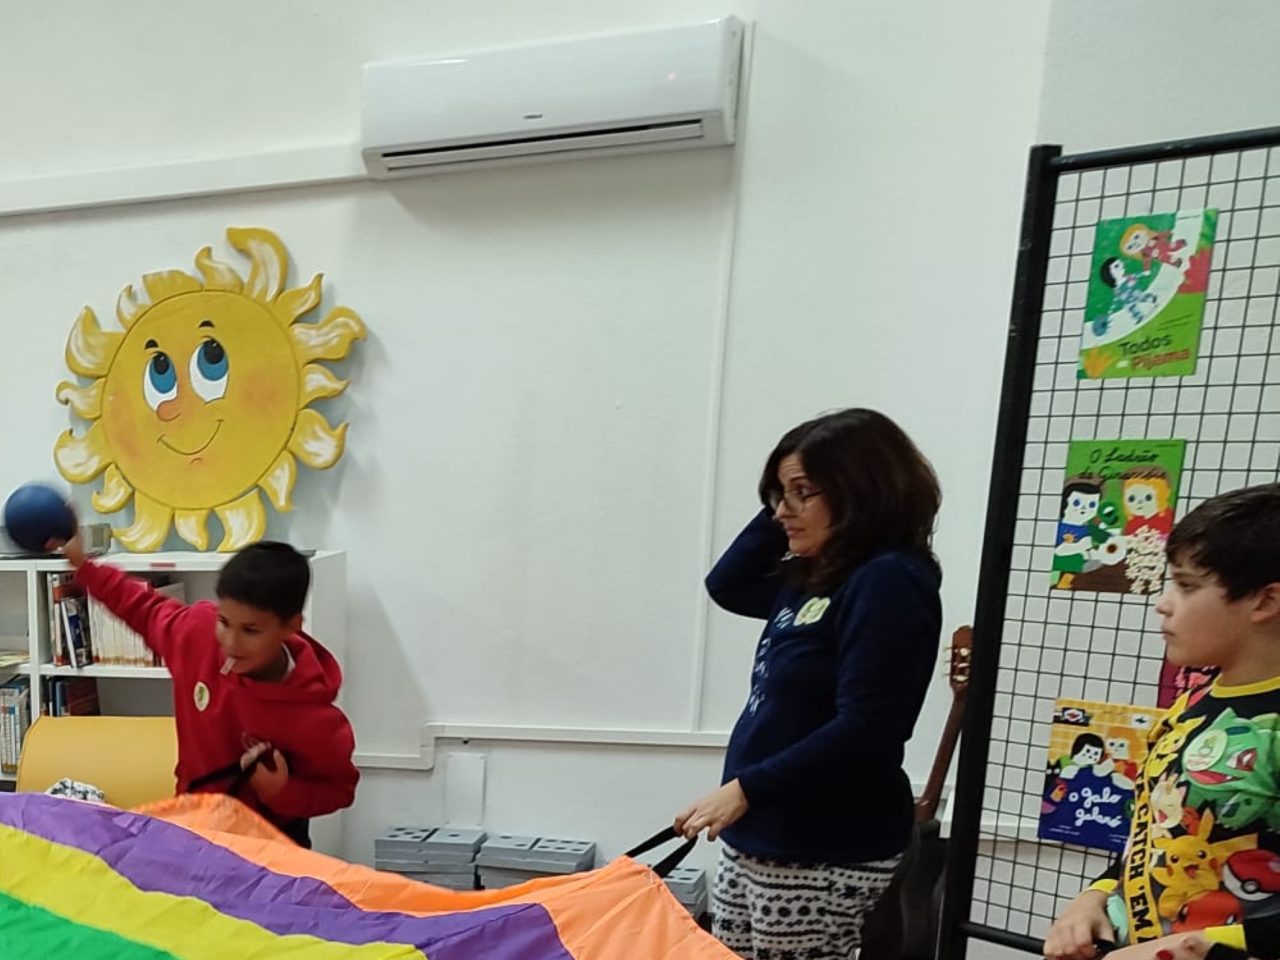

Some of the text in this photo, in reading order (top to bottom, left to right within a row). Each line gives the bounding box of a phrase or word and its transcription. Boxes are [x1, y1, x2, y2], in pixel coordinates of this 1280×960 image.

[1118, 335, 1171, 355] Todos
[1081, 787, 1122, 808] galo
[1130, 804, 1148, 881] CATCH
